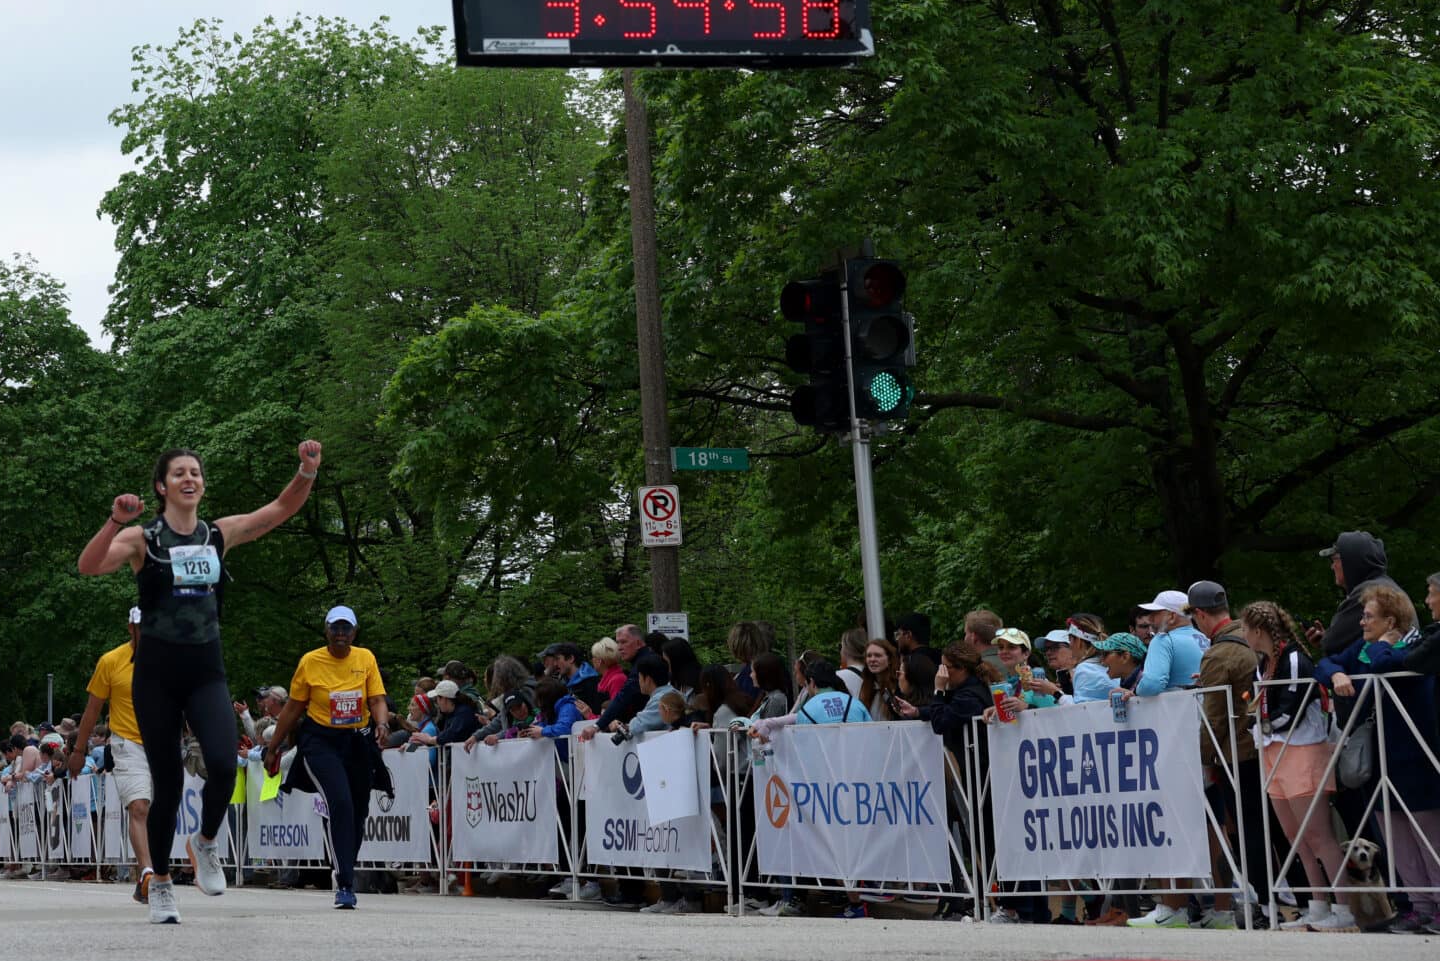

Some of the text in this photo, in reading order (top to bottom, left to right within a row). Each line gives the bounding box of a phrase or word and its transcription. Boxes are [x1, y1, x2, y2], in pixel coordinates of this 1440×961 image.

[688, 451, 733, 466] 18th St
[182, 560, 211, 575] 1213
[335, 700, 358, 711] 4673
[1018, 728, 1161, 799] GREATER
[480, 779, 537, 823] WashU
[1023, 801, 1173, 852] ST. LOUIS INC.
